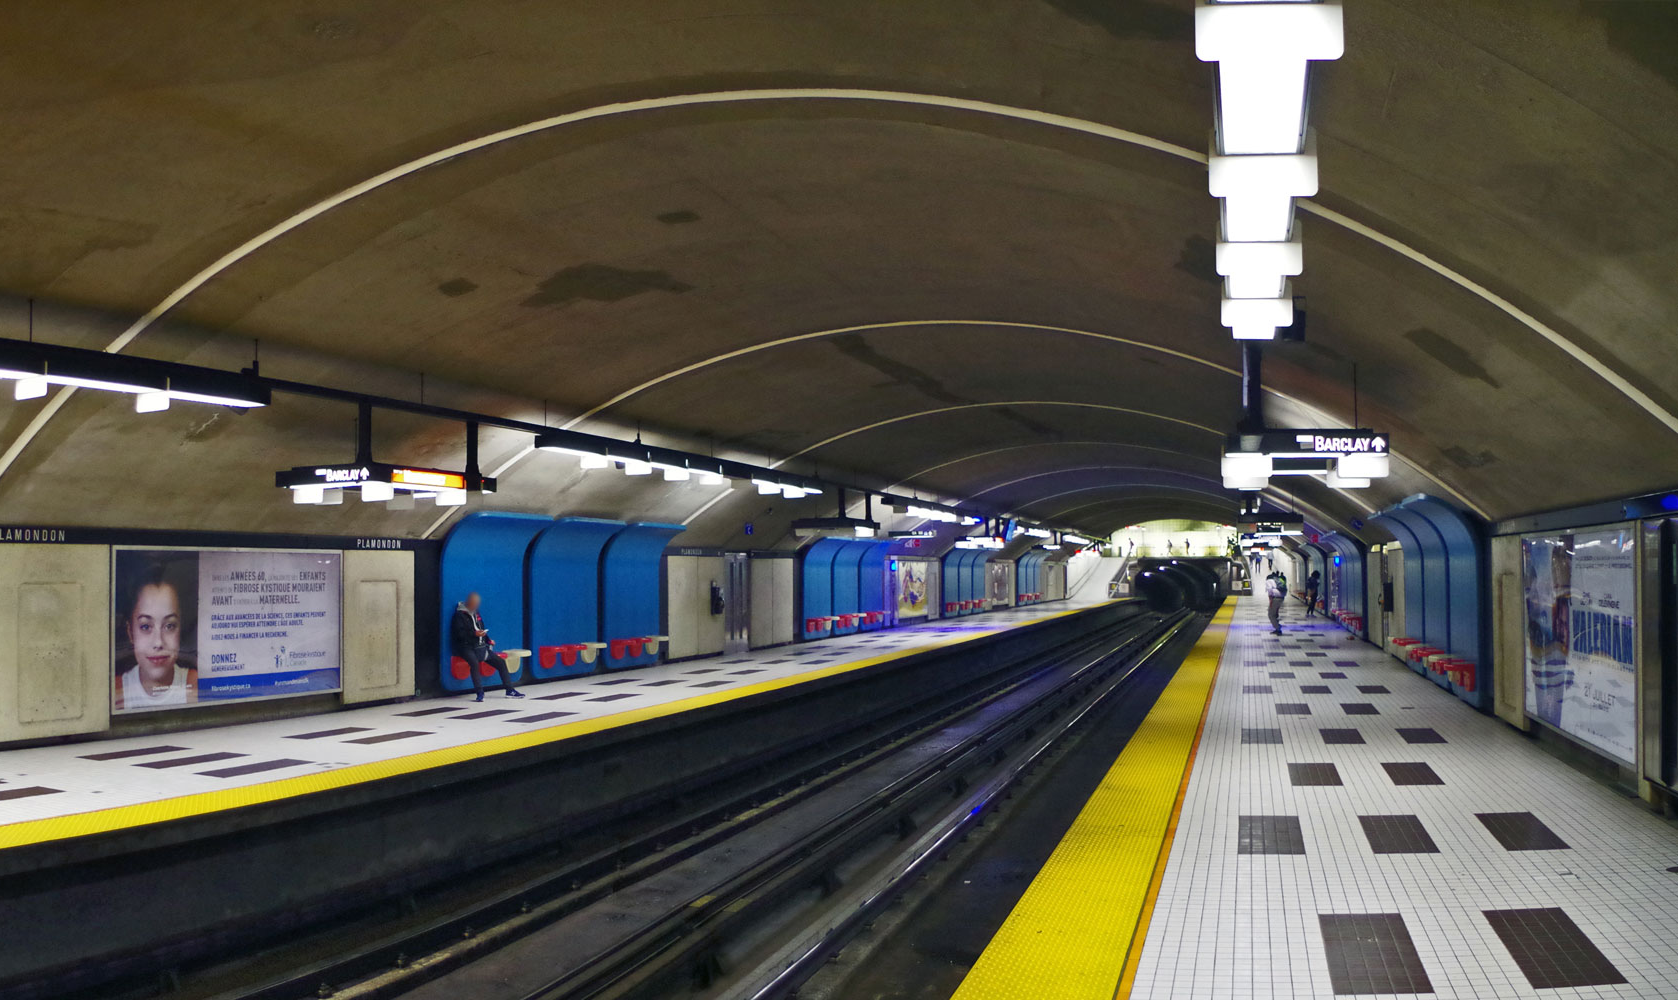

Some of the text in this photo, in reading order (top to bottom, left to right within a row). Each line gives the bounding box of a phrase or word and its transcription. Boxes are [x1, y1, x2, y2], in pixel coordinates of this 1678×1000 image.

[1314, 435, 1370, 451] BARCLAY
[326, 469, 360, 482] BARCLAY
[357, 538, 401, 549] PLAMONDON
[231, 569, 256, 580] ANNÉES
[300, 571, 326, 580] ENFANTS
[234, 584, 259, 593] FIBROSE
[261, 583, 290, 592] KYSTIQUE
[292, 583, 326, 592] MOURAIENT
[212, 596, 233, 606] AVANT
[260, 595, 300, 604] MATERNELLE.
[212, 653, 237, 664] DONNEZ
